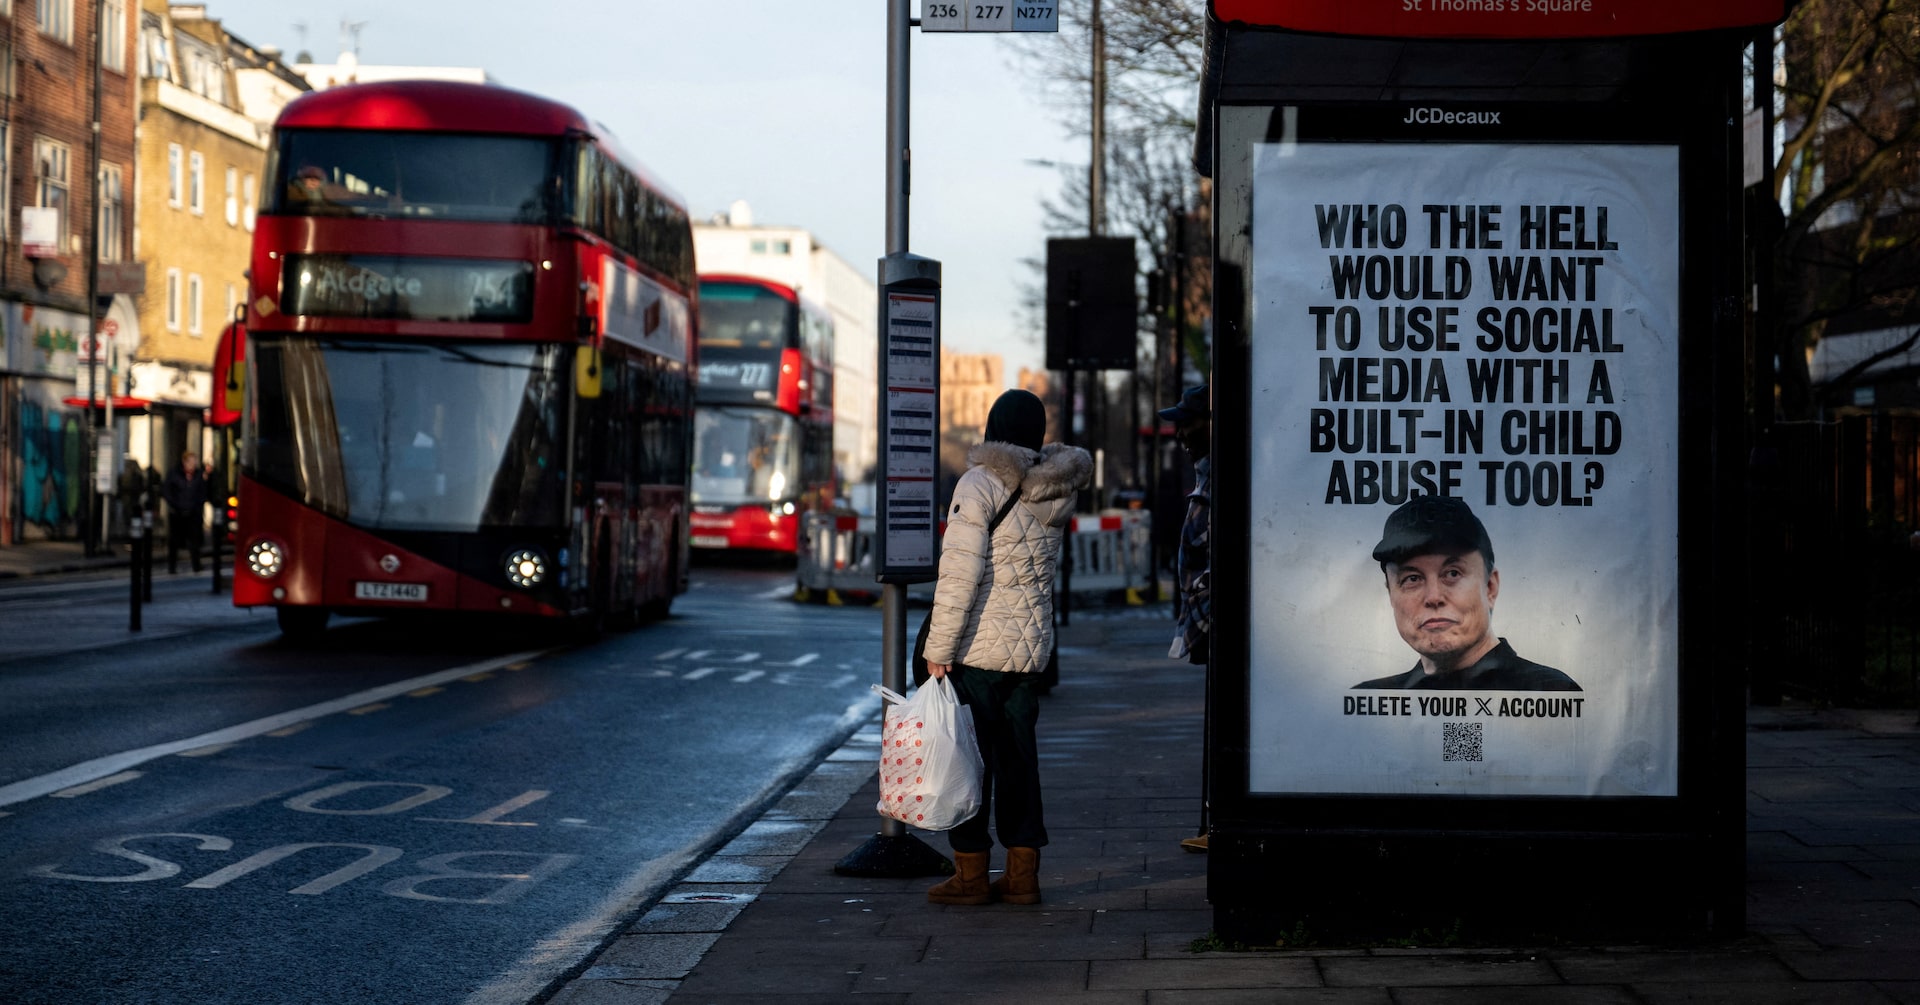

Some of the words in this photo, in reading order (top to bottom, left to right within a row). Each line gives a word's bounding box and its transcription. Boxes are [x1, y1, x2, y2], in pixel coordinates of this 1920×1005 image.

[929, 4, 958, 18] 236
[975, 5, 1004, 19] 277
[1017, 6, 1053, 19] N277
[1402, 0, 1422, 11] St
[1430, 0, 1520, 11] Thomas's
[1526, 0, 1592, 15] Square
[1404, 108, 1500, 124] JCDecaux
[1315, 203, 1407, 250] WHO
[1423, 204, 1503, 250] THE
[1520, 205, 1619, 251] HELL
[319, 270, 422, 301] Aldgate
[468, 271, 516, 309] 254
[1330, 255, 1473, 300] WOULD
[1488, 256, 1603, 302] WANT
[1308, 306, 1361, 351] TO
[1379, 306, 1460, 352] USE
[1476, 307, 1624, 353] SOCIAL
[1318, 357, 1451, 403] MEDIA
[1467, 358, 1570, 404] WITH
[1586, 360, 1615, 404] A
[1310, 408, 1484, 454] BUILT-IN
[1500, 410, 1622, 455] CHILD
[1325, 460, 1464, 505] ABUSE
[1479, 461, 1604, 507] TOOL?
[1344, 695, 1411, 717] DELETE
[1418, 696, 1467, 717] YOUR
[1474, 698, 1494, 716] X
[1499, 698, 1585, 718] ACCOUNT
[34, 832, 577, 904] BUS
